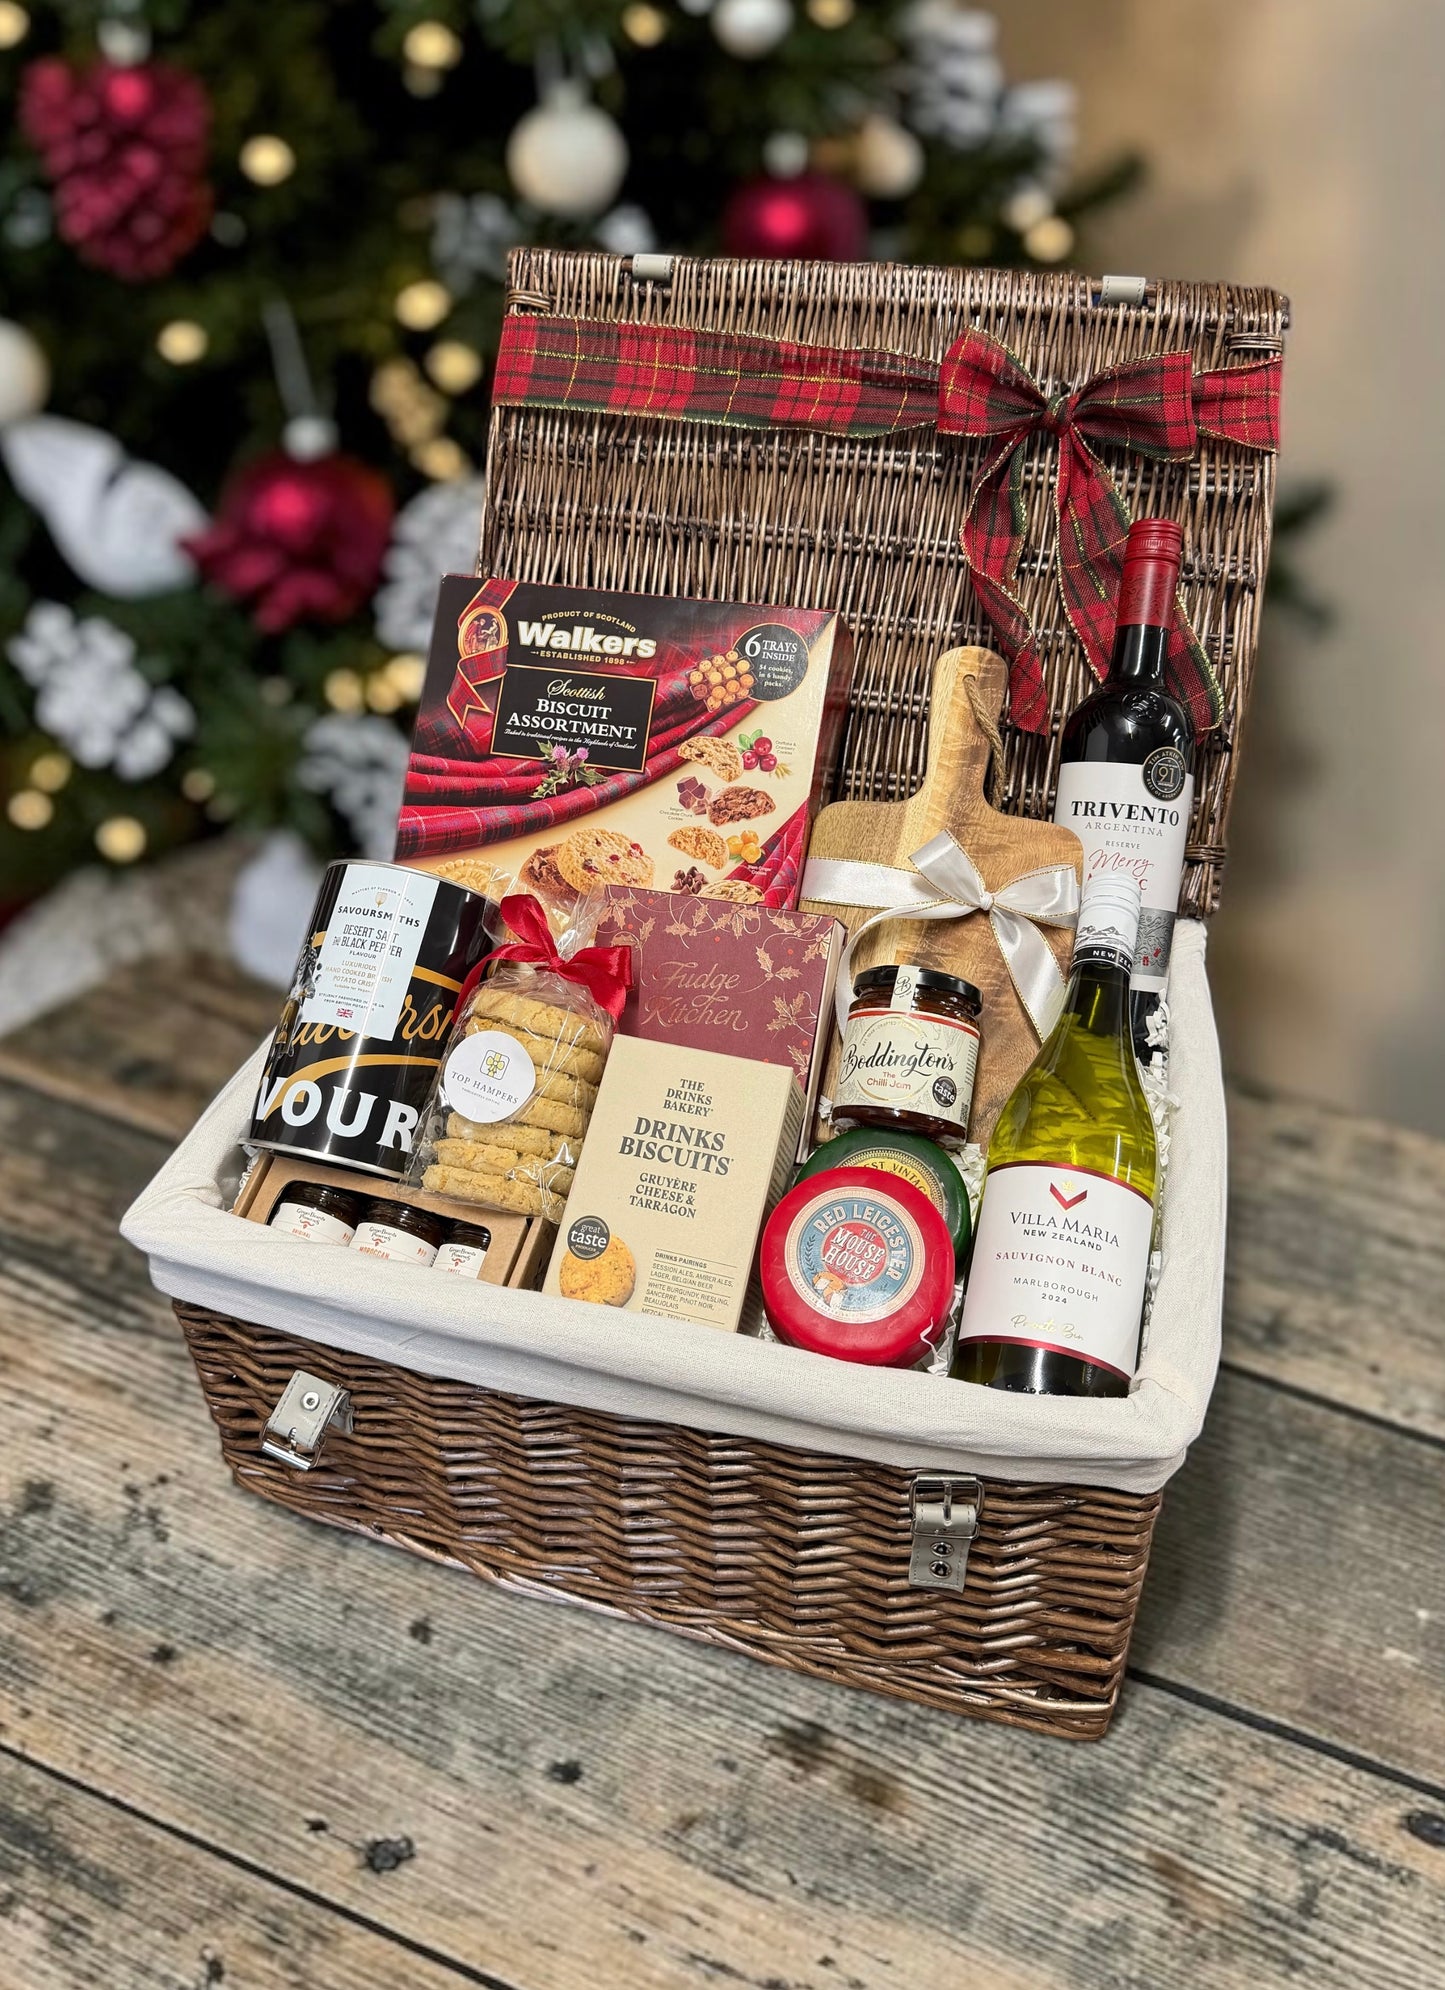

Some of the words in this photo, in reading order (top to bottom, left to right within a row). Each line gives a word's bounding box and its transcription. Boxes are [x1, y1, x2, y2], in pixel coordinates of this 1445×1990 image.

[541, 611, 581, 621] PRODUCT
[595, 613, 637, 633] SCOTLAND
[517, 620, 657, 658] Walkers
[745, 633, 762, 657] 6
[762, 639, 798, 653] TRAYS
[540, 650, 602, 663] ESTABLISHED
[604, 656, 625, 665] 1898
[762, 651, 795, 662] INSIDE
[546, 678, 607, 701] Scottish
[535, 698, 612, 720] BISCUIT
[506, 712, 637, 740] ASSORTMENT
[1148, 754, 1160, 766] TIM
[1161, 750, 1179, 760] ATKIN
[1158, 766, 1174, 784] 91
[1071, 800, 1179, 827] TRIVENTO
[1085, 821, 1164, 837] ARGENTINA
[1105, 840, 1141, 850] RESERVE
[1088, 848, 1155, 877] Merry
[338, 905, 420, 927] SAVOURSMTHS
[341, 936, 368, 950] BLACK
[343, 924, 374, 938] DESERT
[375, 930, 400, 944] SAT
[349, 950, 377, 959] FLAVOUR
[1093, 950, 1116, 960] NEW
[341, 960, 377, 972] LUXURIOUS
[342, 968, 365, 978] COOKED
[333, 976, 357, 985] POTATO
[652, 961, 741, 1008] Fudge
[641, 994, 749, 1032] Kitchen
[841, 1041, 957, 1085] Boddington's
[680, 1078, 705, 1092] THE
[866, 1077, 888, 1087] Chilli
[889, 1080, 911, 1090] Jam
[883, 1071, 896, 1079] The
[451, 1071, 471, 1085] TOP
[472, 1080, 519, 1104] HAMPERS
[666, 1088, 713, 1106] DRINKS
[934, 1082, 955, 1103] taste
[662, 1099, 710, 1118] BAKERY
[633, 1116, 726, 1152] DRINKS
[618, 1135, 730, 1176] BISCUITS
[639, 1172, 698, 1194] GRUYÈRE
[635, 1184, 684, 1204] CHEESE
[685, 1194, 696, 1206] &
[629, 1195, 697, 1219] TARRAGON
[570, 1229, 608, 1248] taste
[581, 1224, 601, 1233] great
[860, 1228, 877, 1241] THE
[1010, 1211, 1058, 1229] VILLA
[1062, 1216, 1120, 1248] MARIA
[813, 1205, 847, 1234] RED
[852, 1203, 907, 1282] LEICESTER
[830, 1227, 886, 1264] MOUSE
[1023, 1228, 1047, 1238] NEW
[1051, 1232, 1102, 1252] ZEALAND
[654, 1251, 678, 1262] DRINKS
[678, 1257, 708, 1269] PAIRINGS
[822, 1245, 876, 1281] HOUSE
[995, 1251, 1076, 1270] SAUVIGNON
[1081, 1263, 1122, 1288] BLANC
[650, 1270, 671, 1281] LAGER,
[671, 1275, 697, 1286] BELGIAN
[697, 1281, 714, 1290] BEER
[652, 1263, 678, 1274] SESSION
[679, 1268, 695, 1278] ALES,
[695, 1273, 717, 1283] AMBER
[717, 1279, 734, 1288] ALES,
[646, 1289, 679, 1302] SANCERRE,
[679, 1297, 698, 1306] PINOT
[698, 1302, 714, 1311] NOIR,
[647, 1281, 666, 1291] WHITE
[666, 1285, 700, 1299] BURGUNDY,
[700, 1293, 729, 1306] RIESLING,
[1013, 1277, 1099, 1302] MARLBOROUGH
[1041, 1292, 1067, 1304] 2024
[643, 1296, 679, 1310] BEAUJOLAIS
